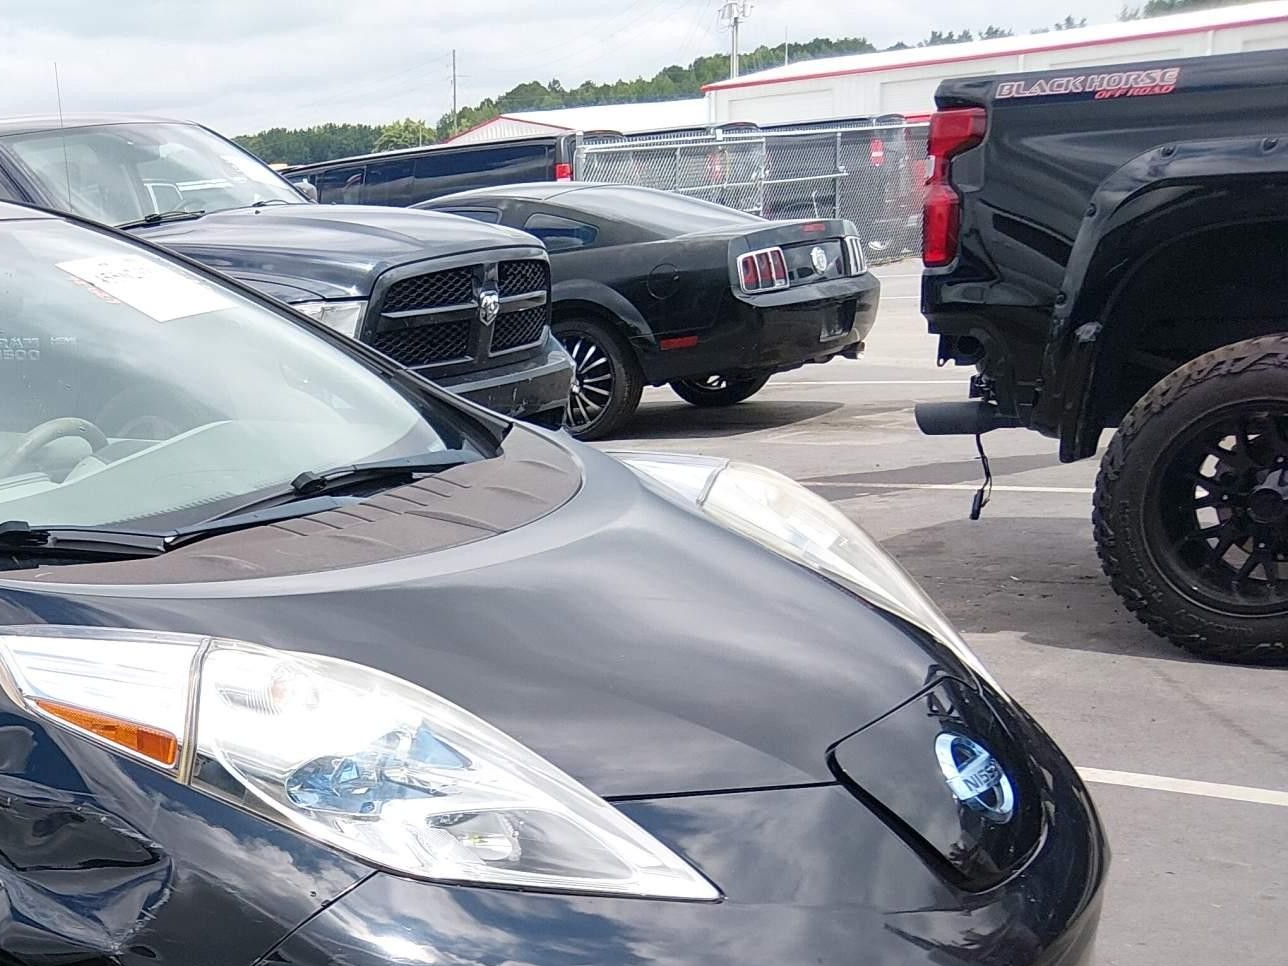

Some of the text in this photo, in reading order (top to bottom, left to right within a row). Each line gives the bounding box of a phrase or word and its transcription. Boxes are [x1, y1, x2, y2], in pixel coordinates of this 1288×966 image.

[995, 67, 1182, 100] BLACK HORSE
[1094, 84, 1175, 100] OFF ROAD
